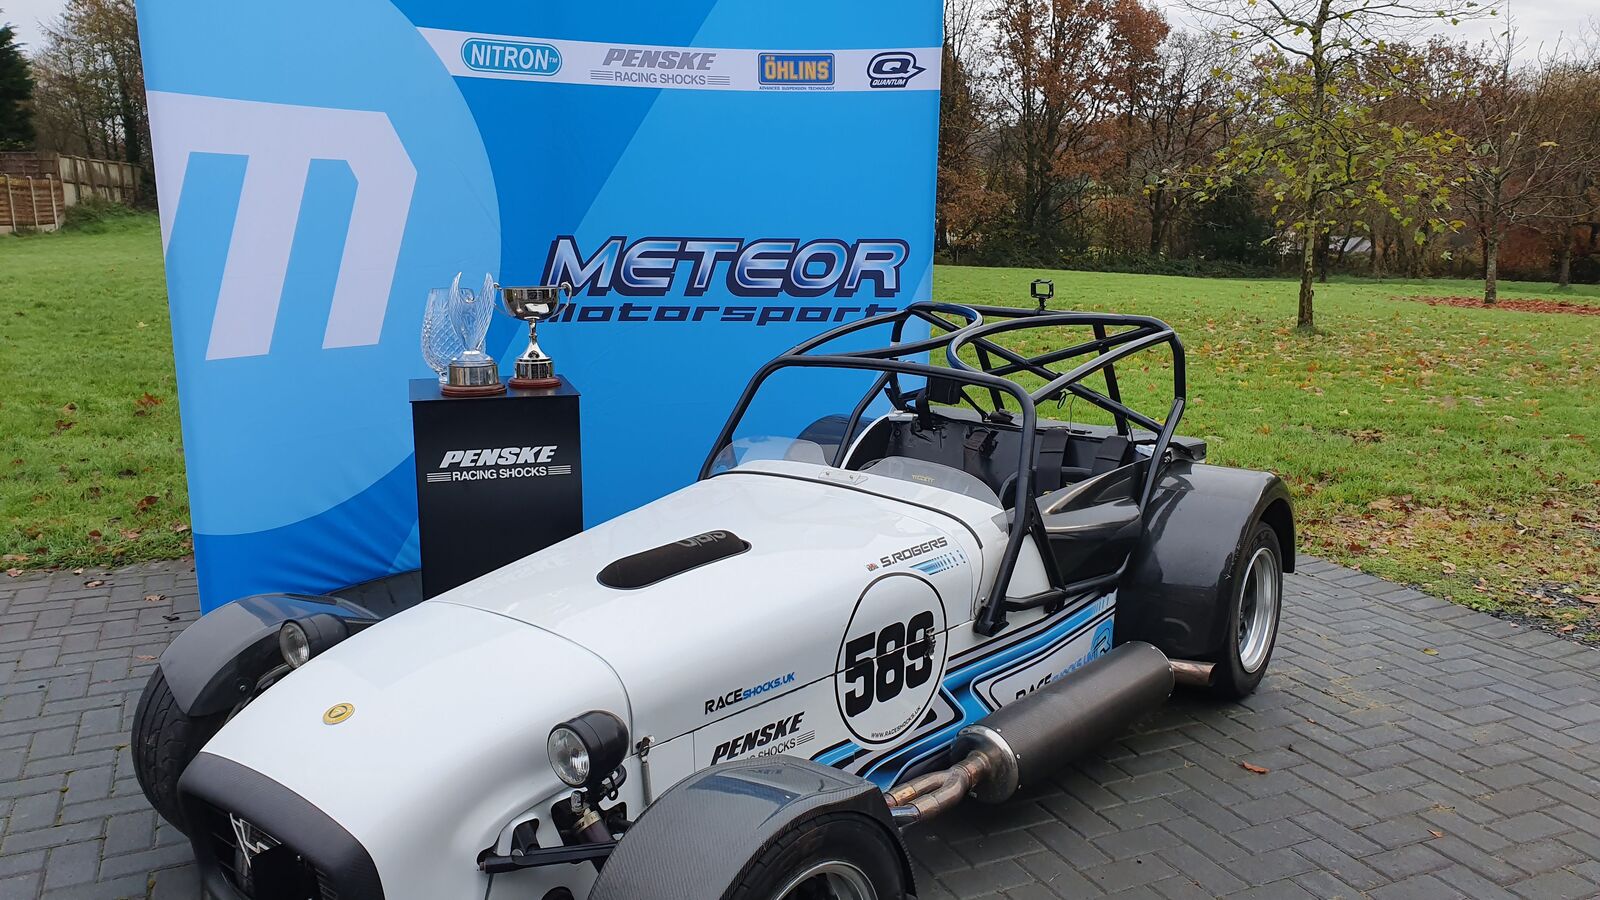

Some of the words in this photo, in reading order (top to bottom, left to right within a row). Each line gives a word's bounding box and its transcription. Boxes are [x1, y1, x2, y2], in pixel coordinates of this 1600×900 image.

[470, 43, 549, 70] NITRON
[602, 48, 717, 70] PENSKE
[764, 56, 830, 80] ÖHLINS
[614, 71, 657, 84] RACING
[659, 73, 706, 85] SHOCKS
[871, 78, 907, 86] QUANTUM
[540, 235, 910, 298] METEOR
[438, 445, 558, 469] PENSKE
[452, 469, 497, 481] RACING
[499, 466, 547, 479] SHOCKS
[879, 536, 948, 568] S.ROGERS
[845, 610, 935, 718] 589
[704, 671, 796, 715] RACESHOCKS.UK
[710, 710, 806, 766] PENSKE
[757, 737, 796, 759] SHOCKS
